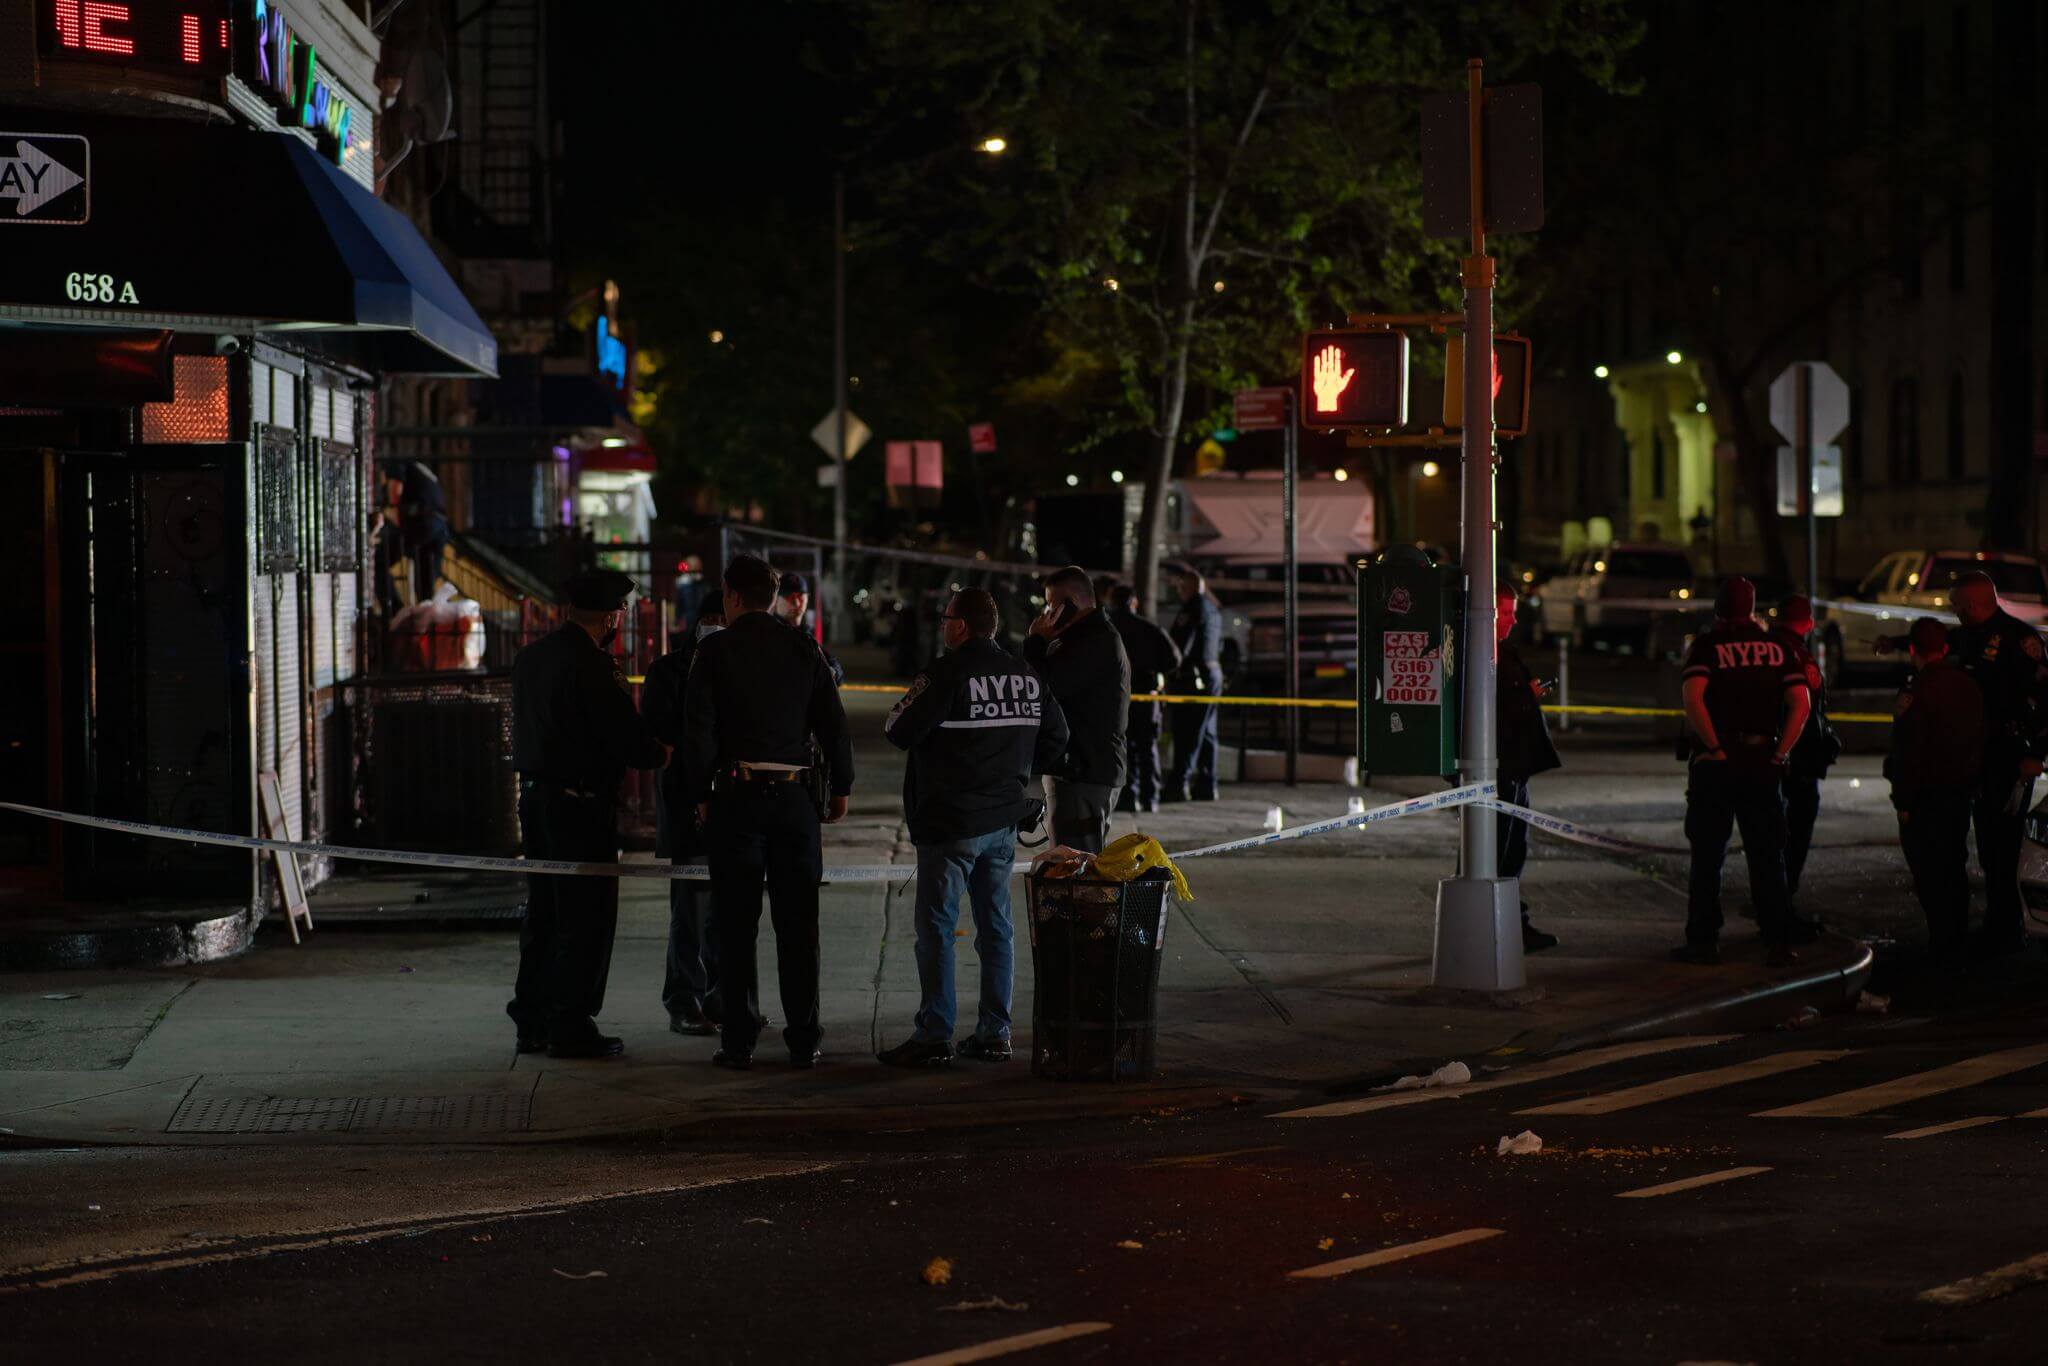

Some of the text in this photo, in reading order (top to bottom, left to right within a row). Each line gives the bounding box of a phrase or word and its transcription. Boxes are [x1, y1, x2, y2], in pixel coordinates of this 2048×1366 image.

[65, 271, 140, 304] 658 A
[1714, 641, 1784, 669] NYPD
[1391, 660, 1434, 673] (516)
[968, 674, 1040, 702] NYPD
[1392, 674, 1431, 687] 232
[1386, 688, 1437, 701] 0007
[969, 702, 1041, 719] POLICE
